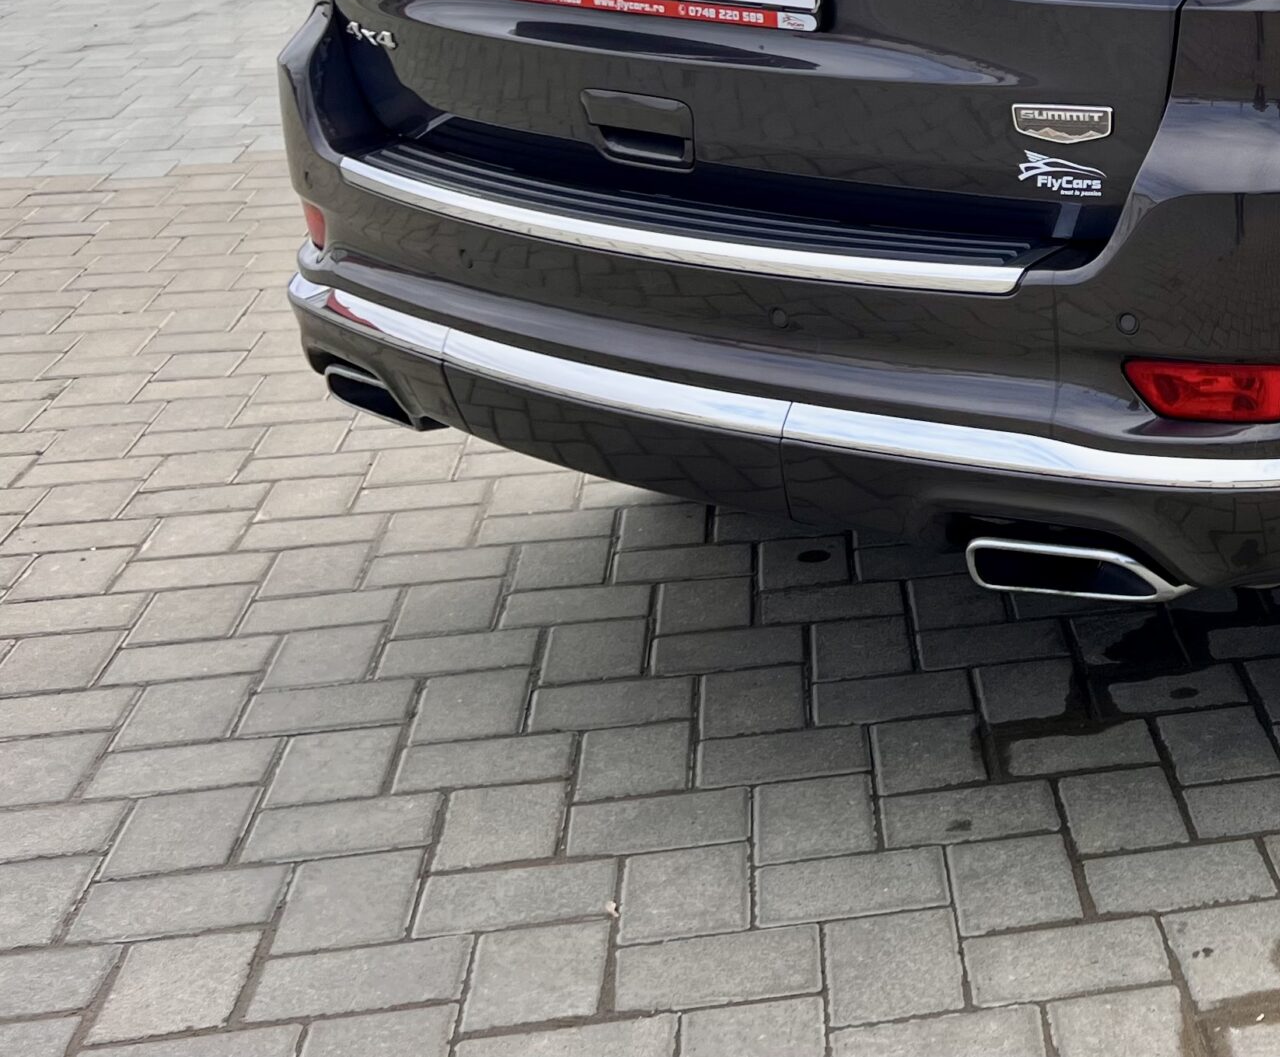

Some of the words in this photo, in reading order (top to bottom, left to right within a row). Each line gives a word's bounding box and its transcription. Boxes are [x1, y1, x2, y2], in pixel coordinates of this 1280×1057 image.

[688, 6, 716, 19] 0748
[719, 9, 740, 21] 220
[1020, 109, 1104, 122] SUMMIT
[1036, 175, 1102, 191] FlyCars
